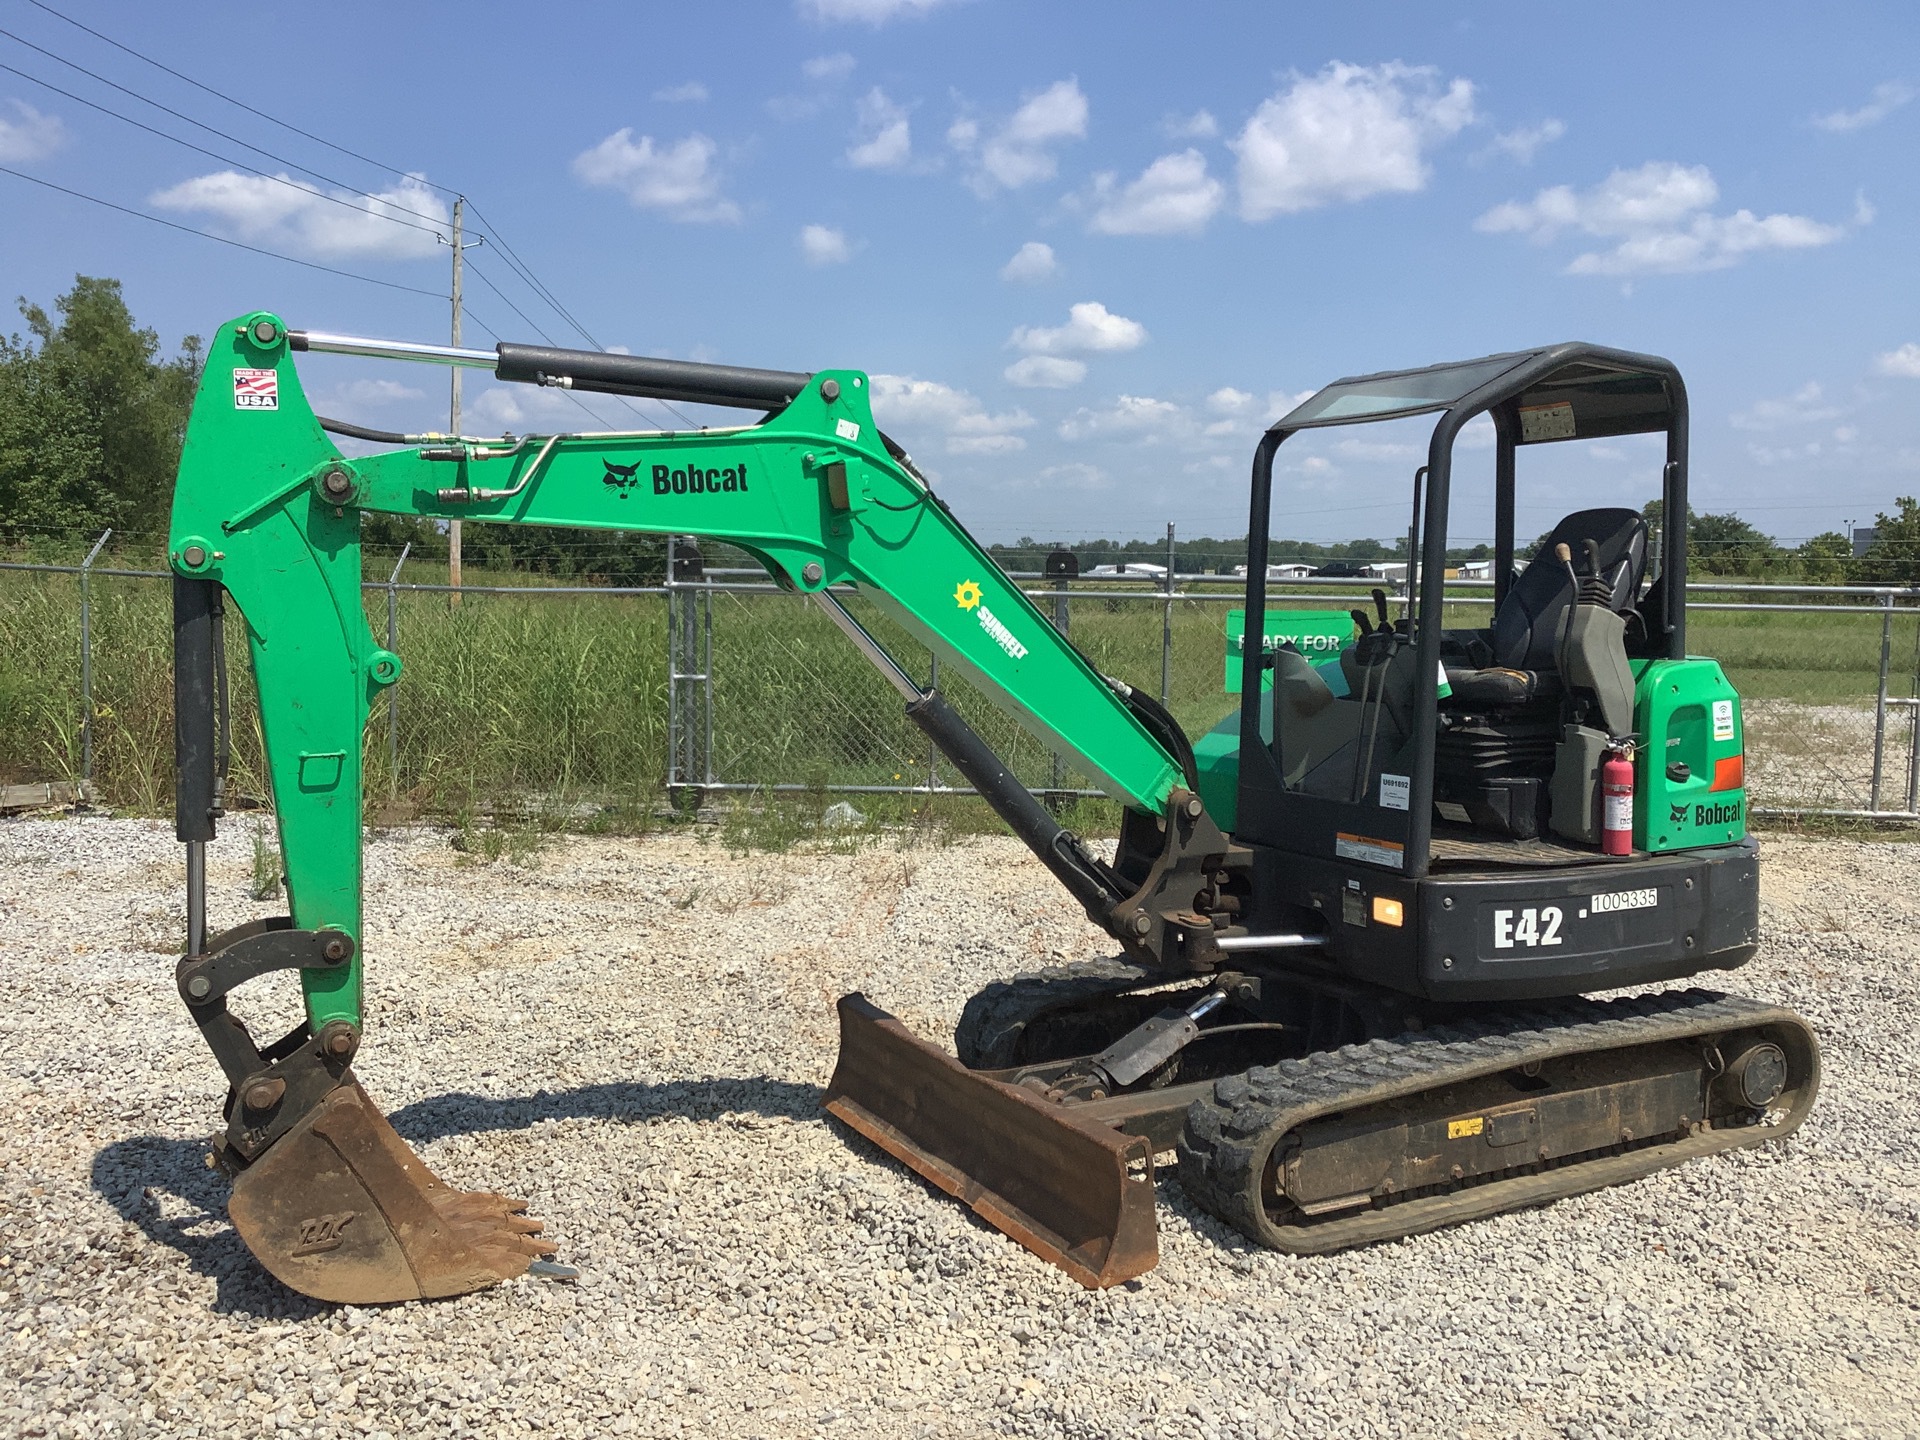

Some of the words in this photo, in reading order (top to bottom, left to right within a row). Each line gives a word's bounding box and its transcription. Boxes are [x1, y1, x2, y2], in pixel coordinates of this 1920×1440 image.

[237, 395, 275, 406] USA
[652, 463, 748, 495] Bobcat
[976, 605, 1029, 660] SUNBELT
[979, 621, 1015, 659] RENTALS
[1238, 634, 1299, 651] RADY
[1303, 635, 1340, 651] FOR
[1695, 800, 1741, 827] Bobcat
[1594, 889, 1656, 911] 1009335
[1494, 906, 1563, 948] E42
